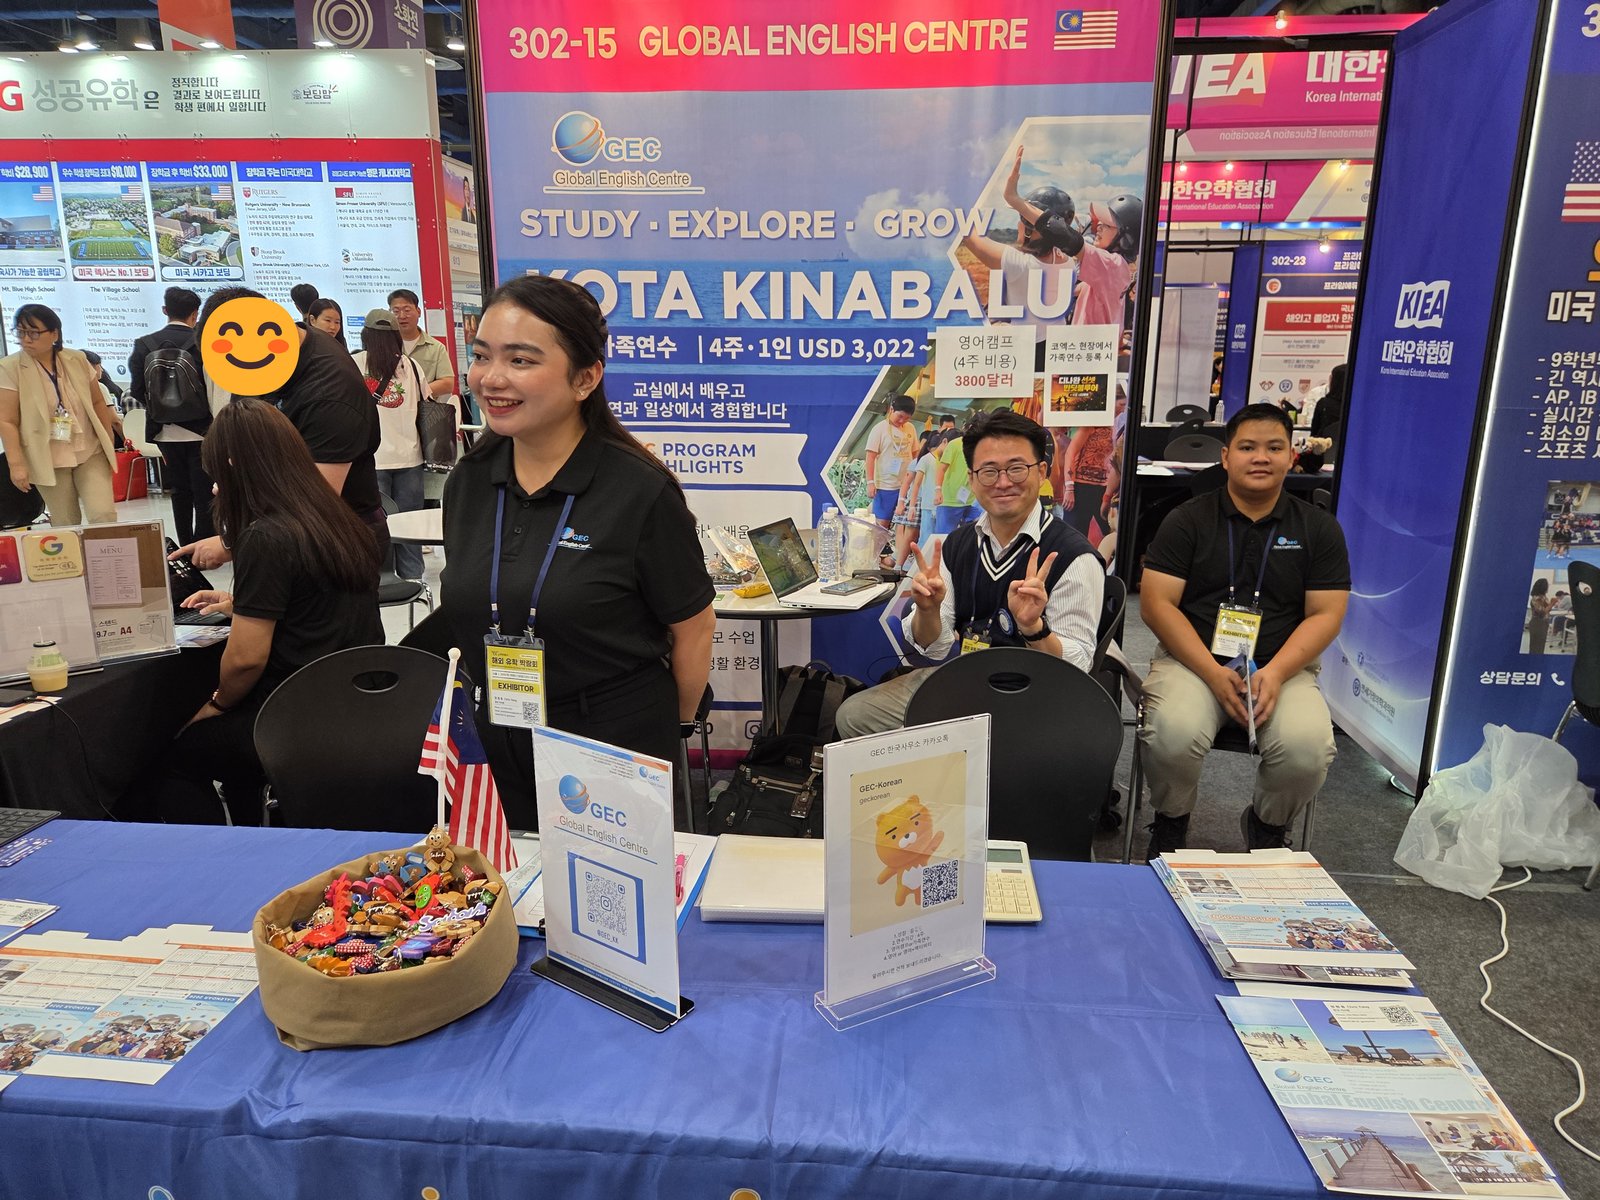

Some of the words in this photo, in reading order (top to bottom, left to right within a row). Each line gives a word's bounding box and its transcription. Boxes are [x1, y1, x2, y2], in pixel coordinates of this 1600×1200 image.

[509, 27, 616, 59] 302-15
[640, 24, 759, 58] GLOBAL
[767, 22, 896, 56] ENGLISH
[900, 18, 1027, 54] CENTRE
[1306, 51, 1386, 84] 대한
[172, 77, 218, 88] 정직합니다
[1171, 53, 1266, 99] IEA
[173, 89, 201, 100] 결과로
[205, 89, 260, 100] 보여드립니다
[1305, 91, 1336, 103] Korea
[174, 101, 193, 112] 학생
[197, 101, 225, 112] 편에서
[229, 101, 266, 112] 일합니다
[604, 138, 662, 164] GEC
[554, 170, 594, 190] Global
[598, 170, 644, 190] English
[648, 170, 690, 188] Centre
[520, 208, 639, 239] STUDY
[668, 208, 834, 239] EXPLORE
[873, 207, 994, 238] GROW
[1272, 256, 1307, 266] 302-23
[78, 268, 93, 277] 미국
[118, 268, 133, 277] No.1
[134, 268, 149, 277] 보딩
[175, 268, 189, 278] 미국
[191, 268, 213, 278] 시카고
[216, 268, 230, 278] 보딩
[103, 286, 118, 294] Village
[528, 270, 702, 320] OTA
[723, 269, 1076, 320] KINABALU
[1399, 289, 1445, 321] KIEA
[1547, 291, 1596, 323] 미국
[797, 337, 846, 360] USD
[958, 335, 1013, 350] 영어캠프
[1050, 341, 1078, 351] 코엑스
[1079, 341, 1112, 351] 현장에서
[1049, 352, 1083, 363] 가족연수
[1085, 352, 1102, 363] 등록
[1105, 352, 1113, 362] 시
[1382, 340, 1454, 366] 대한유학협회
[953, 354, 979, 371] (4주
[984, 354, 1017, 371] 비용)
[955, 372, 1013, 388] 3800달러
[1548, 370, 1565, 387] 긴
[633, 382, 694, 400] 교실에서
[700, 382, 746, 400] 배우고
[1544, 389, 1573, 407] AP,
[1580, 390, 1598, 405] IB
[608, 401, 638, 418] 연과
[644, 401, 705, 418] 일상에서
[710, 402, 787, 420] 경험합니다
[1543, 407, 1594, 423] 실시간
[1540, 425, 1588, 441] 최소의
[663, 443, 756, 458] PROGRAM
[1537, 443, 1586, 459] 스포츠
[666, 459, 744, 474] HLIGHTS
[572, 534, 589, 542] GEC
[100, 547, 123, 556] MENU
[120, 626, 132, 636] A4
[728, 631, 755, 645] 수업
[491, 656, 504, 666] 해외
[506, 657, 518, 667] 유학
[733, 656, 760, 671] 환경
[1479, 671, 1541, 687] 상담문의
[498, 682, 534, 693] EXHIBITOR
[870, 747, 886, 758] GEC
[887, 740, 921, 754] 한국사무소
[859, 777, 903, 794] GEC-Korean
[858, 792, 891, 806] geckorean
[590, 802, 628, 828] GEC
[559, 815, 585, 834] Global
[587, 824, 618, 846] English
[619, 836, 649, 856] Centre
[1303, 1074, 1333, 1085] GEC
[1277, 1091, 1343, 1108] Global
[1349, 1092, 1418, 1112] English
